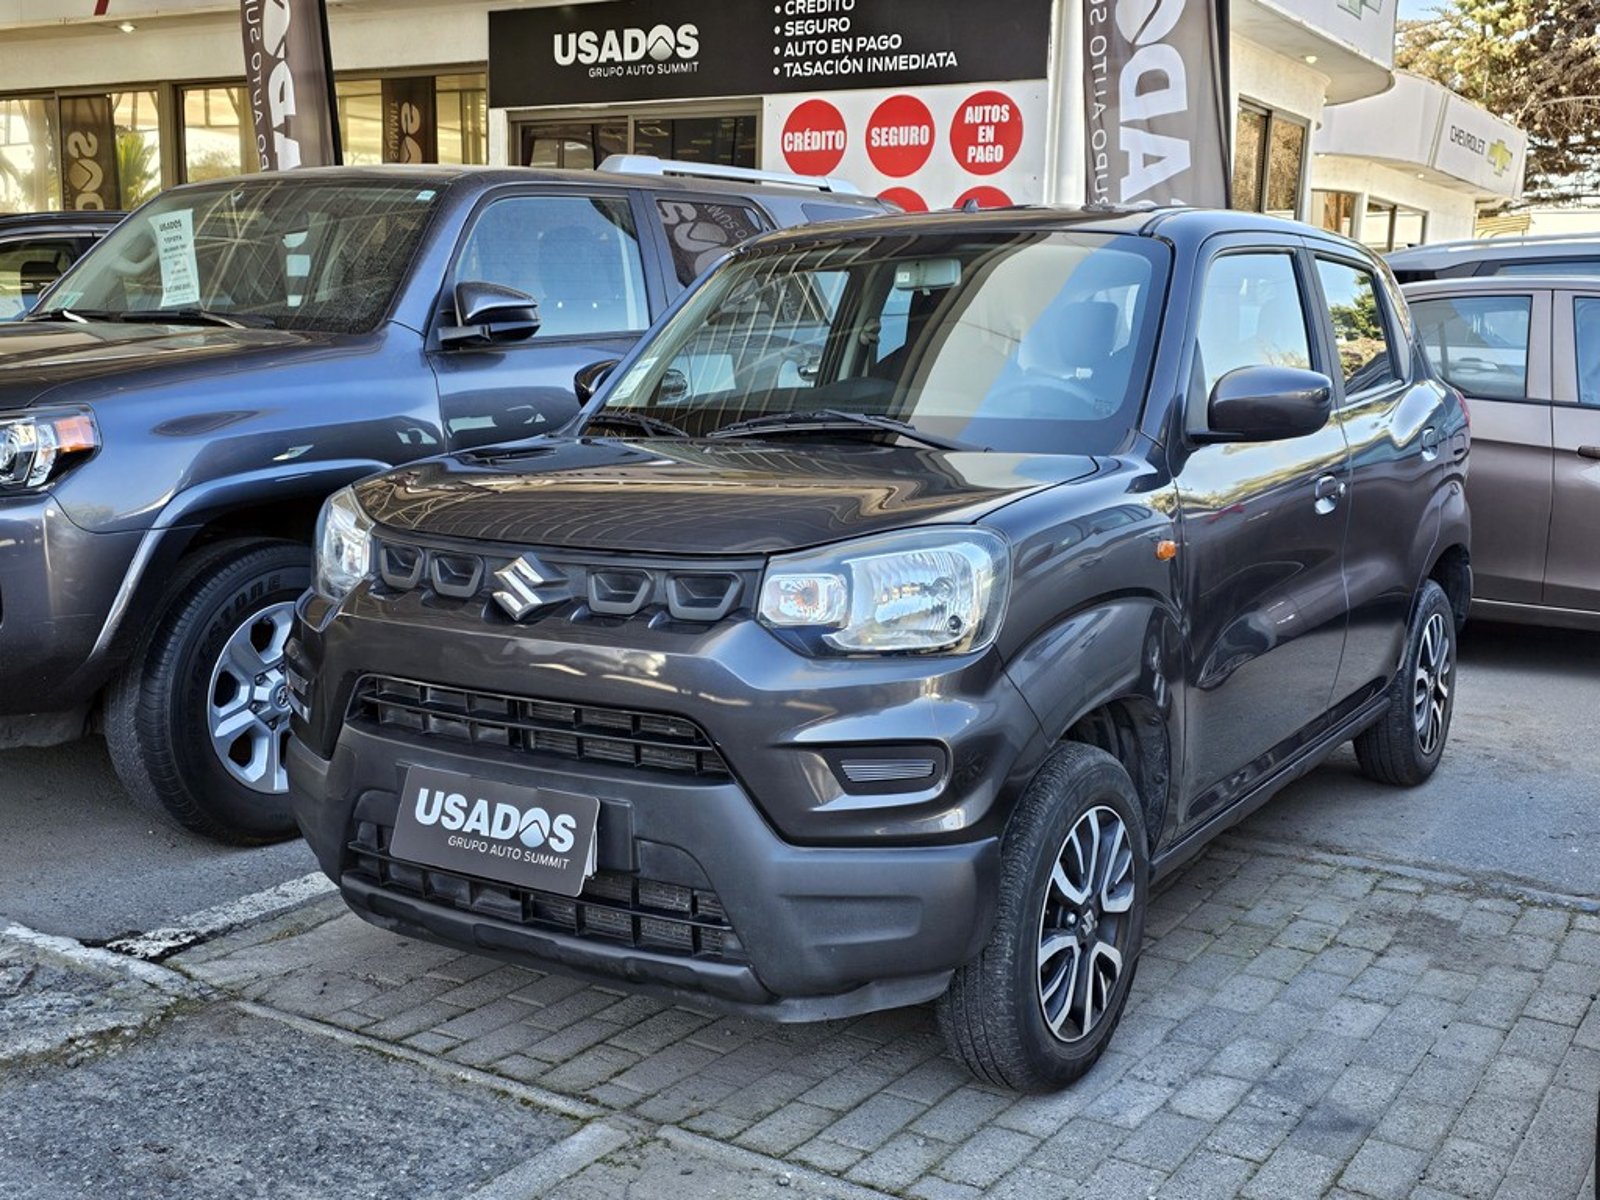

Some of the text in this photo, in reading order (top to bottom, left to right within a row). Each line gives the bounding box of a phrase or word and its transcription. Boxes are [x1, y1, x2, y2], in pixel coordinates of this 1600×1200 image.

[784, 17, 850, 36] SEGURO
[554, 24, 699, 66] USADOS
[784, 34, 902, 57] AUTO EN PAGO
[588, 61, 699, 78] GRUPO AUTO SUMMIT
[784, 51, 958, 77] TASACIÓN INMEDIATA
[964, 104, 1010, 124] AUTOS
[783, 128, 846, 152] CRÉDITO
[871, 125, 930, 148] SEGURO
[977, 125, 995, 144] EN
[1449, 125, 1486, 155] CHEVROLET
[967, 145, 1004, 163] PAGO
[415, 787, 577, 853] USADOS
[448, 835, 570, 870] GRUPO AUTO SUMMIT
